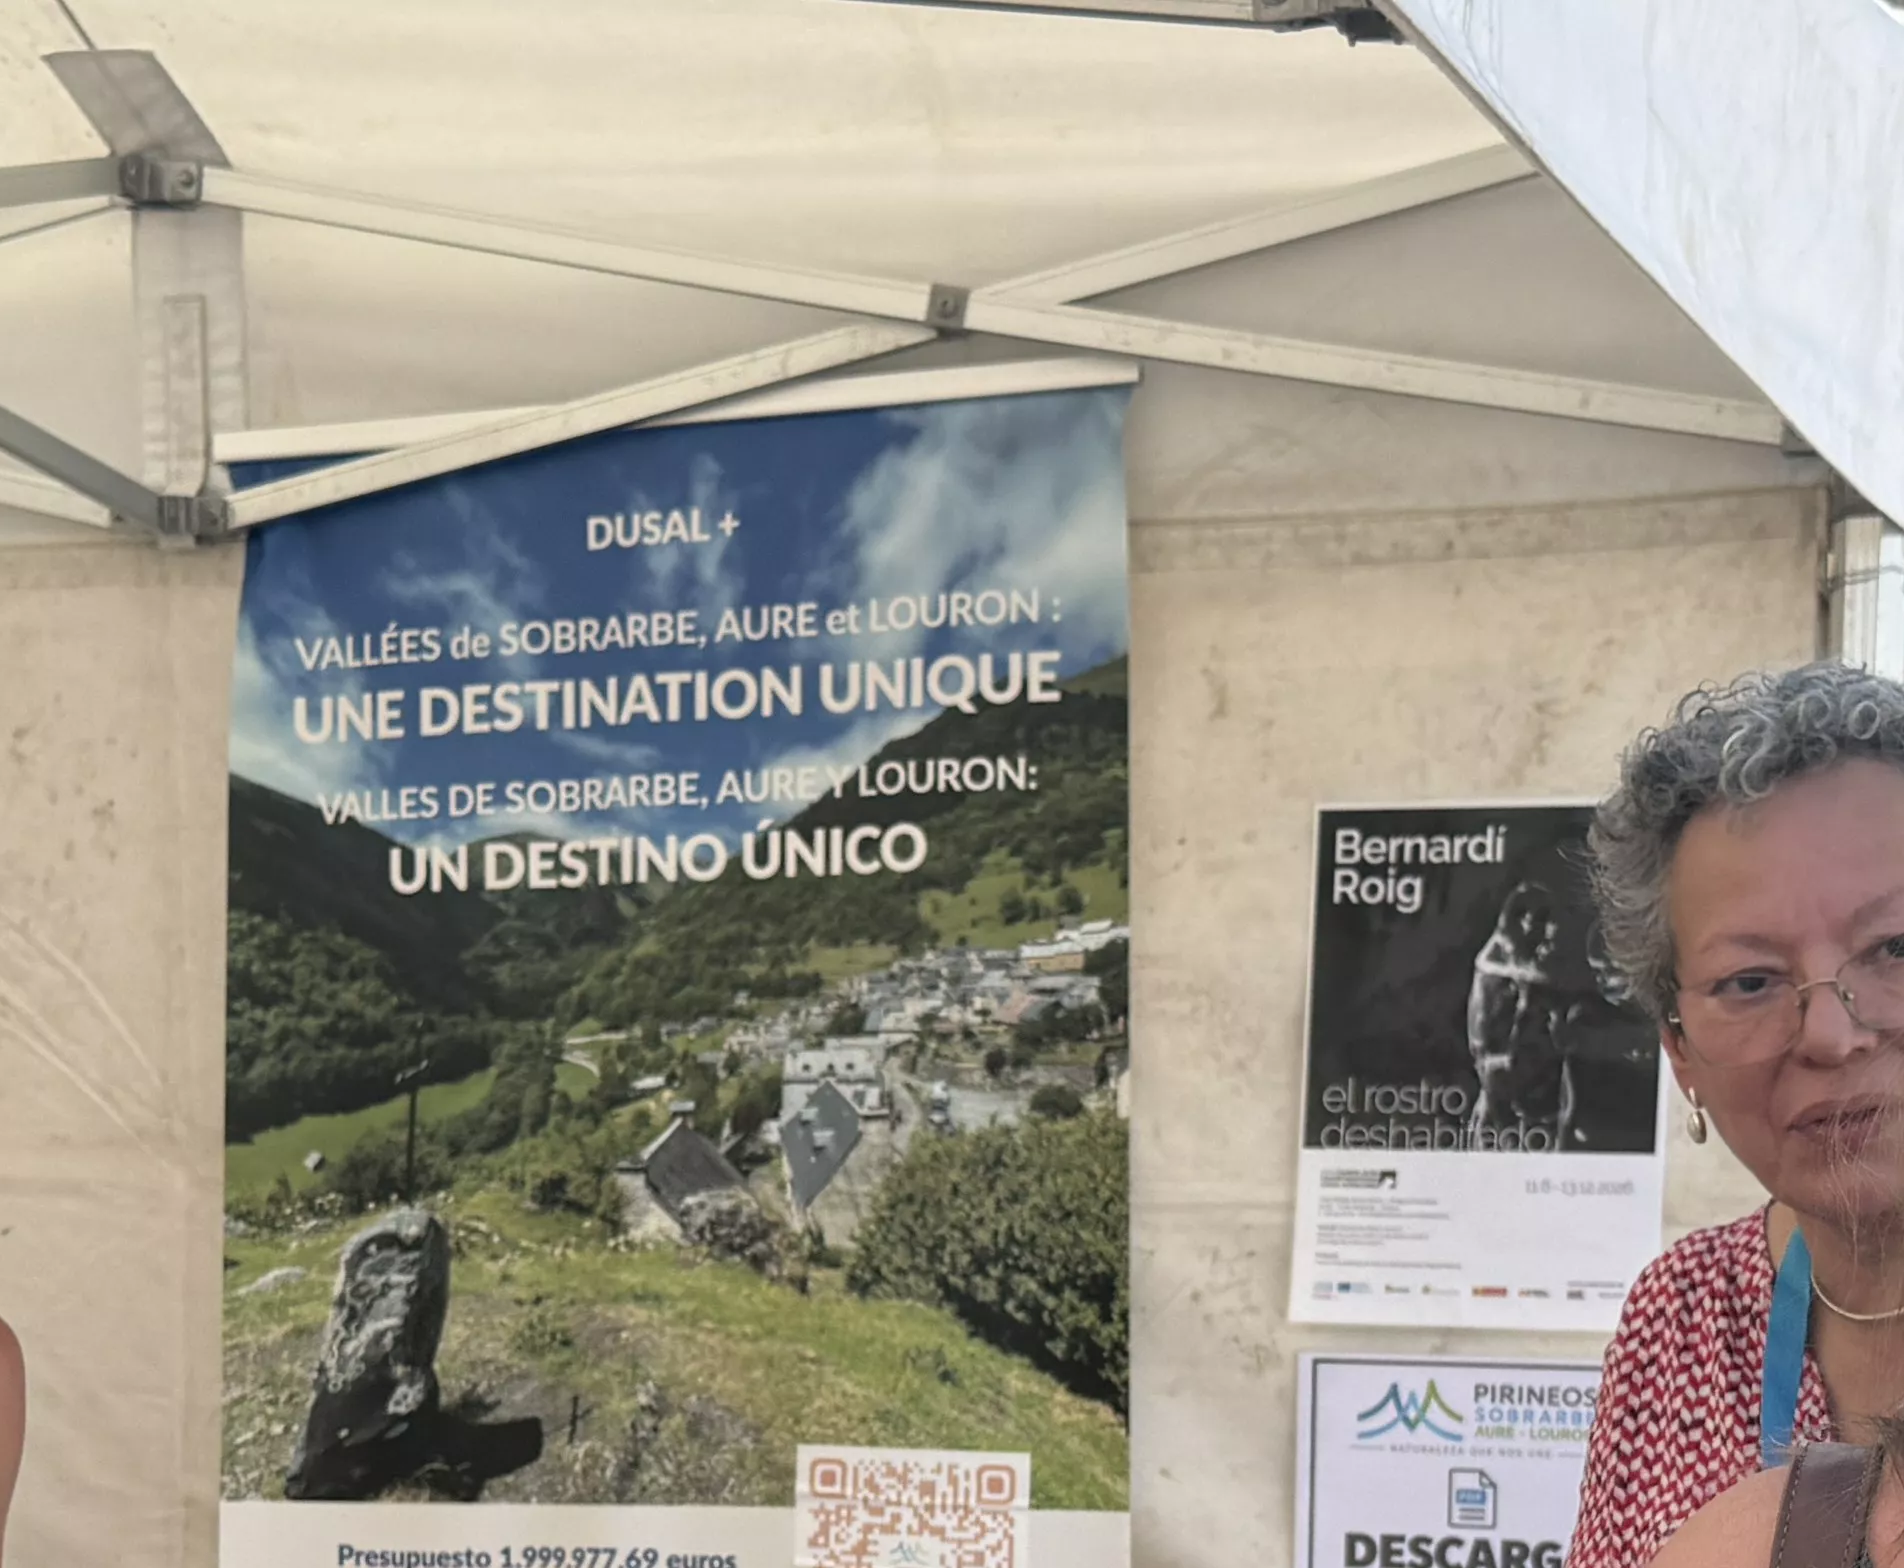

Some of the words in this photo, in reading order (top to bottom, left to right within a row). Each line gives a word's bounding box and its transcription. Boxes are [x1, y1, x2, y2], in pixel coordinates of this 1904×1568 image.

[585, 510, 710, 552] DUSAL
[718, 512, 741, 538] +
[295, 622, 442, 671] VALLÉES
[449, 626, 491, 660] de
[499, 610, 708, 657] SOBRARBE,
[714, 602, 819, 644] AURE
[825, 604, 861, 636] et
[869, 587, 1040, 633] LOURON
[294, 690, 406, 744] UNE
[419, 662, 803, 738] DESTINATION
[818, 649, 1062, 715] UNIQUE
[318, 785, 439, 826] VALLES
[448, 784, 495, 817] DE
[504, 771, 710, 816] SOBRARBE,
[716, 766, 819, 804] AURE
[824, 763, 854, 799] Y
[858, 755, 1039, 799] LOURON:
[388, 845, 469, 895] UN
[484, 833, 727, 890] DESTINO
[742, 818, 929, 882] ÚNICO
[1332, 866, 1423, 914] Roig
[1322, 1076, 1357, 1115] el
[1363, 1076, 1468, 1116] rostro
[1473, 1383, 1597, 1408] PIRINEOS
[1474, 1425, 1515, 1439] AURE
